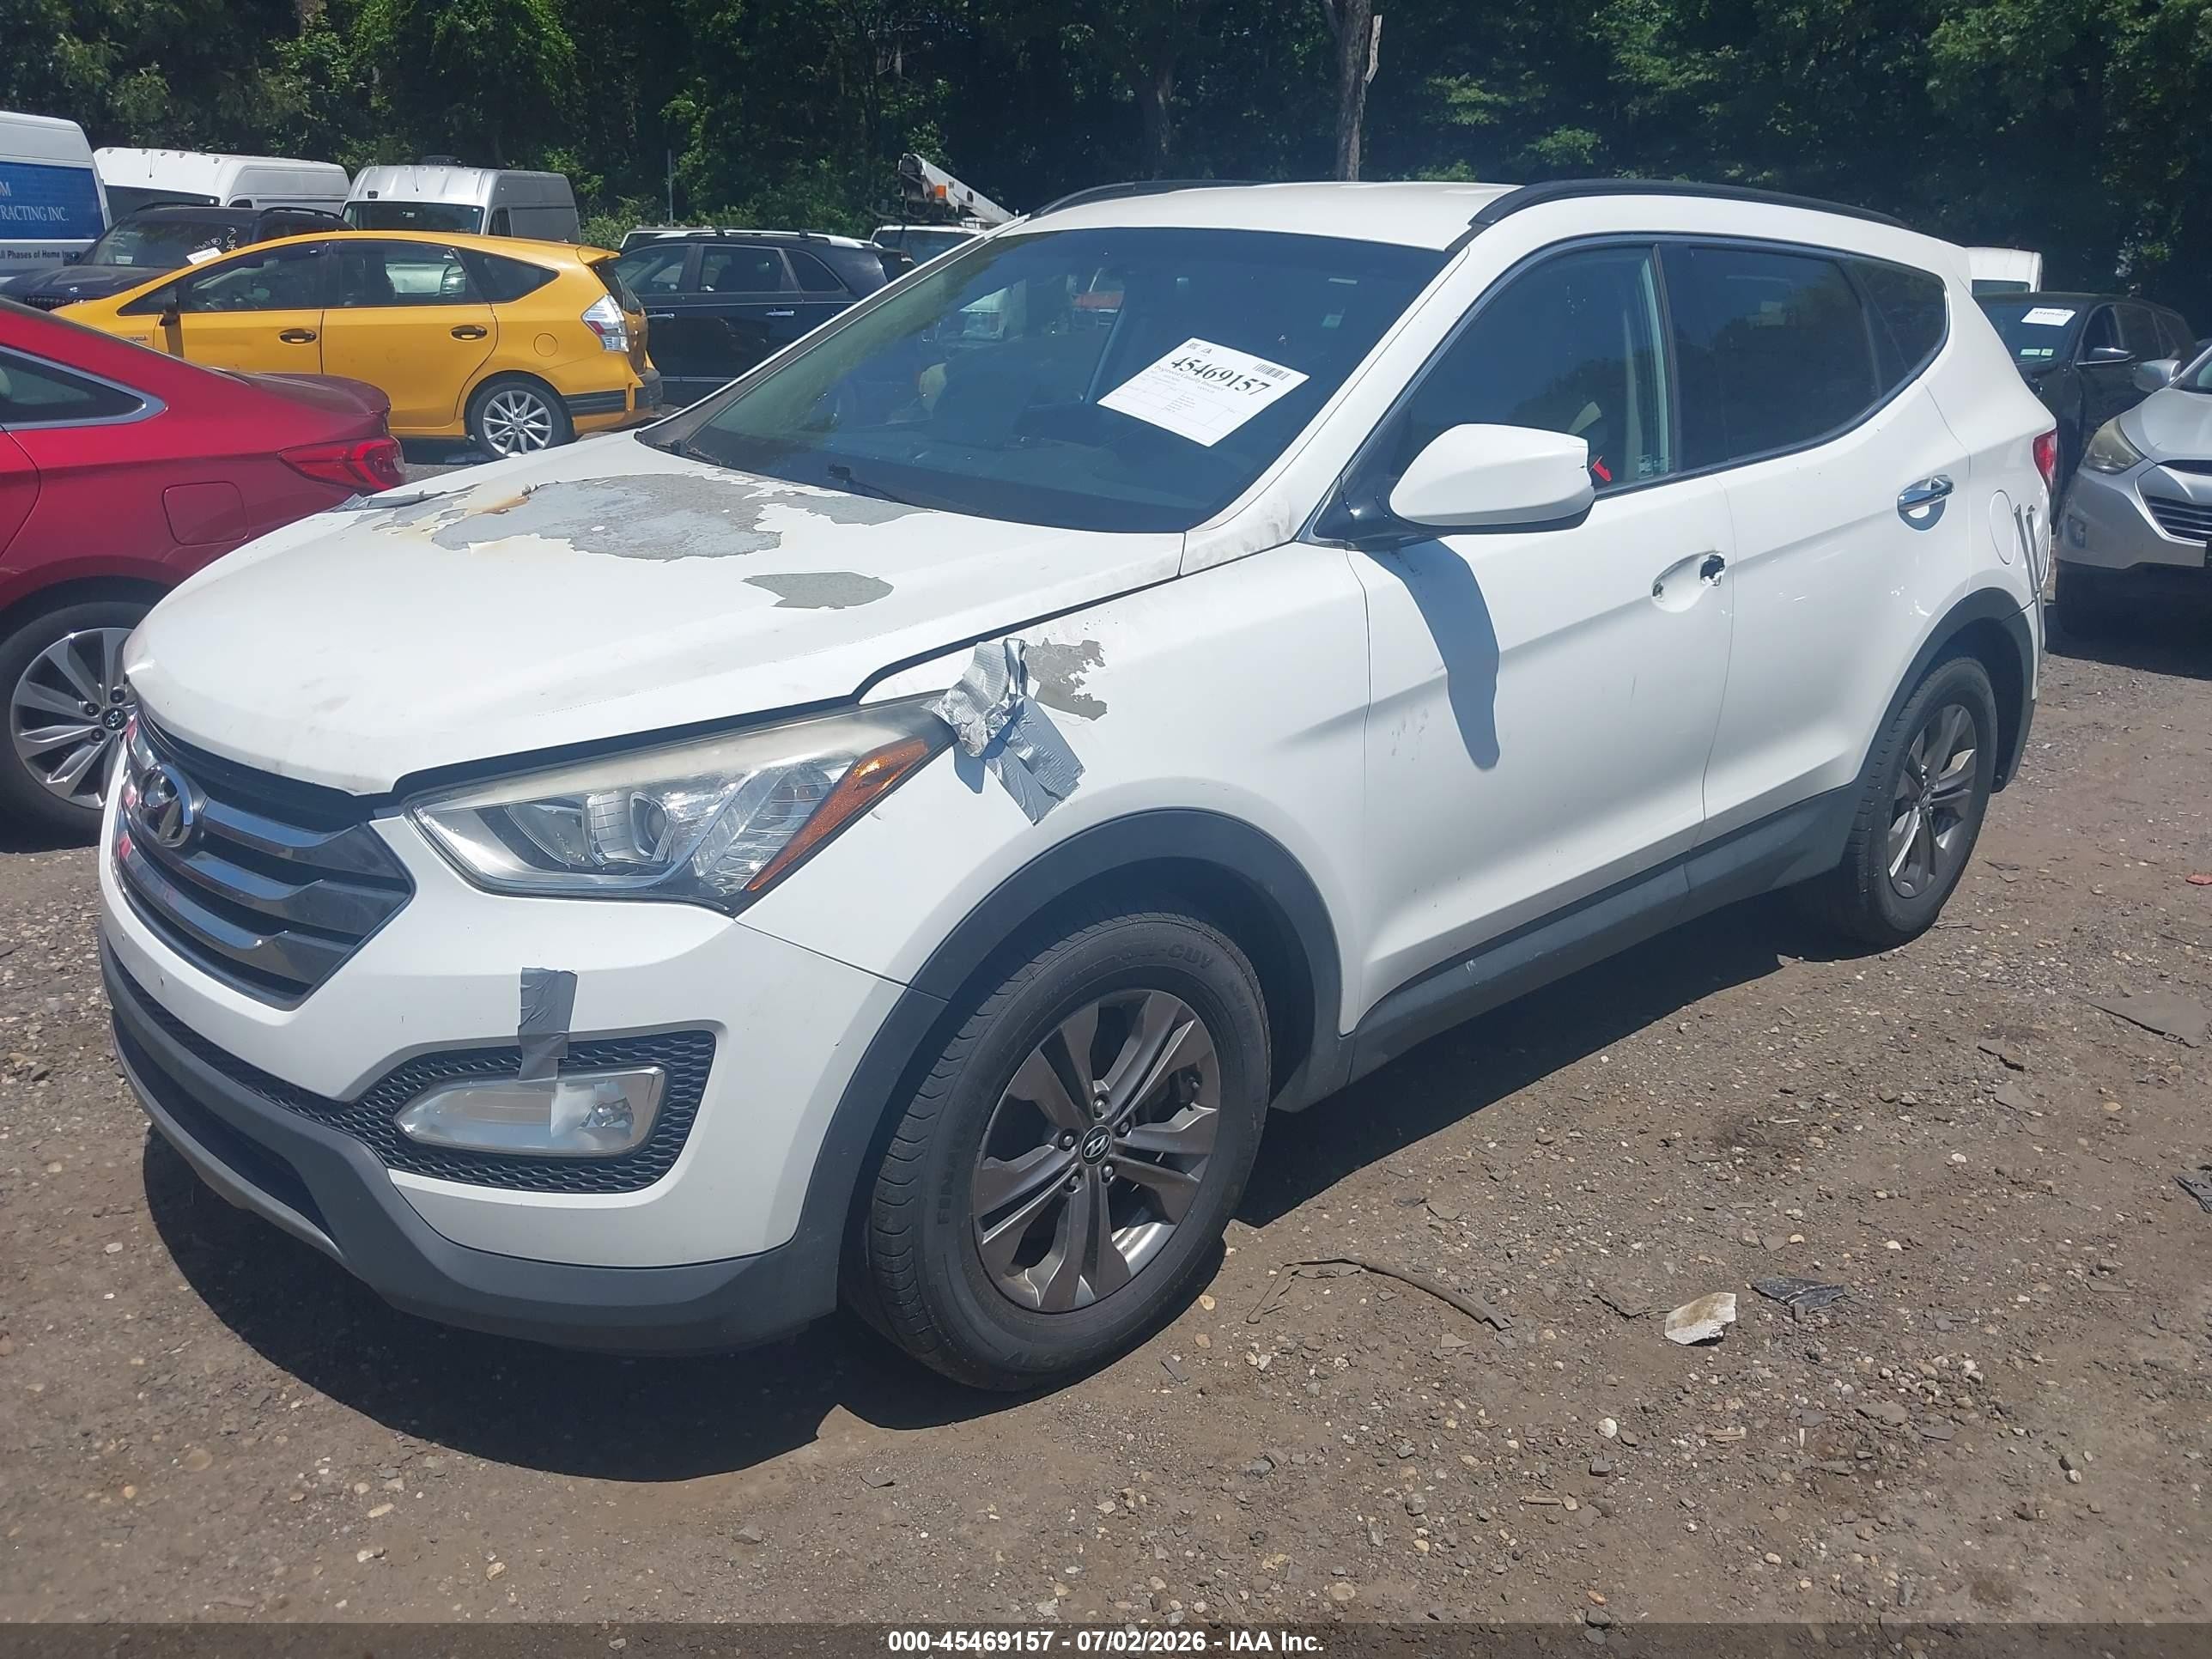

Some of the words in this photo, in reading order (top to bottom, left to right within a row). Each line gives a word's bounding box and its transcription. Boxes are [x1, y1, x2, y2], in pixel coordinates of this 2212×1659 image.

[47, 206, 70, 222] INC.
[7, 250, 32, 258] Phases
[41, 250, 60, 258] Home
[1170, 356, 1272, 396] 45469157
